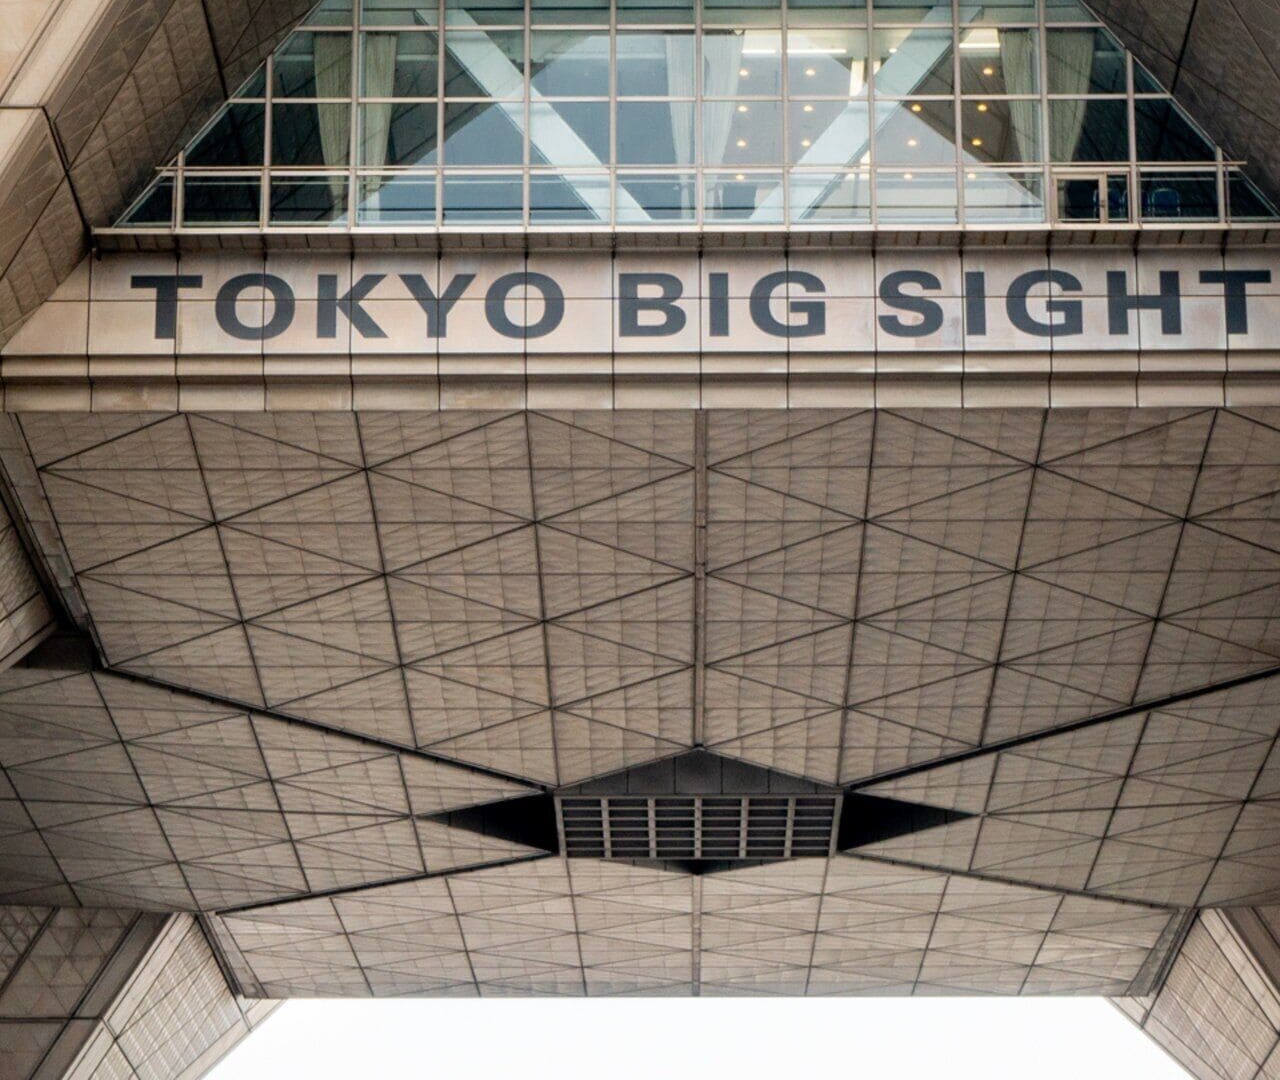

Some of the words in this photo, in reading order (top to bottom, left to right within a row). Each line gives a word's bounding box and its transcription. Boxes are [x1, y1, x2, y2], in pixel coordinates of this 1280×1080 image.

[131, 272, 565, 339] TOKYO
[619, 271, 826, 338] BIG
[878, 269, 1272, 337] SIGHT
